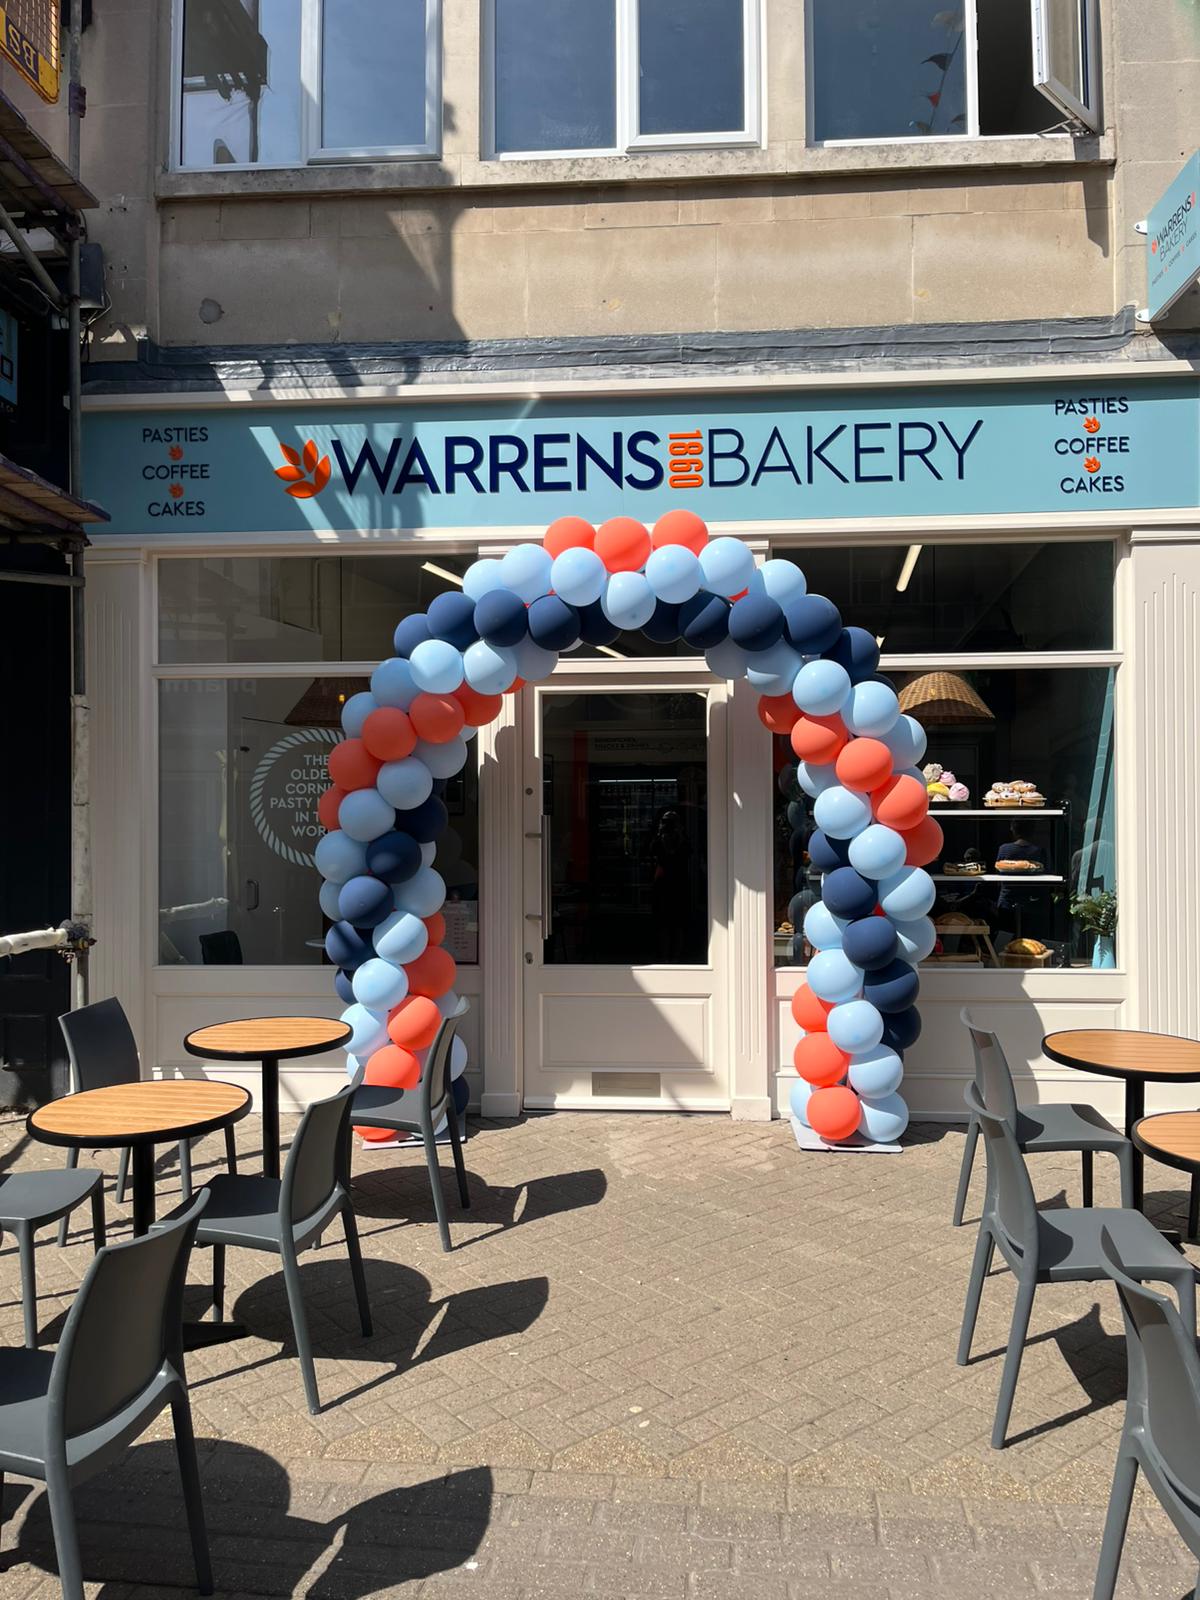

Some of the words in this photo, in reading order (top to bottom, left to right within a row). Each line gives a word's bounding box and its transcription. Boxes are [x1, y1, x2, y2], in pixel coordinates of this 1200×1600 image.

[1156, 194, 1193, 248] WARRENS
[1159, 215, 1189, 263] BAKERY
[1054, 396, 1129, 415] PASTIES
[141, 426, 209, 444] PASTIES
[1054, 436, 1130, 455] COFFEE
[331, 429, 664, 496] WARRENS
[668, 429, 704, 489] 1860
[708, 418, 985, 488] BAKERY
[141, 463, 211, 481] COFFEE
[1060, 475, 1125, 494] CAKES
[147, 500, 206, 518] CAKES
[303, 754, 330, 766] THE
[290, 768, 333, 780] OLDE
[285, 783, 336, 794] CORNI
[270, 797, 312, 809] PASTY
[295, 811, 310, 823] IN
[291, 825, 328, 837] WOR
